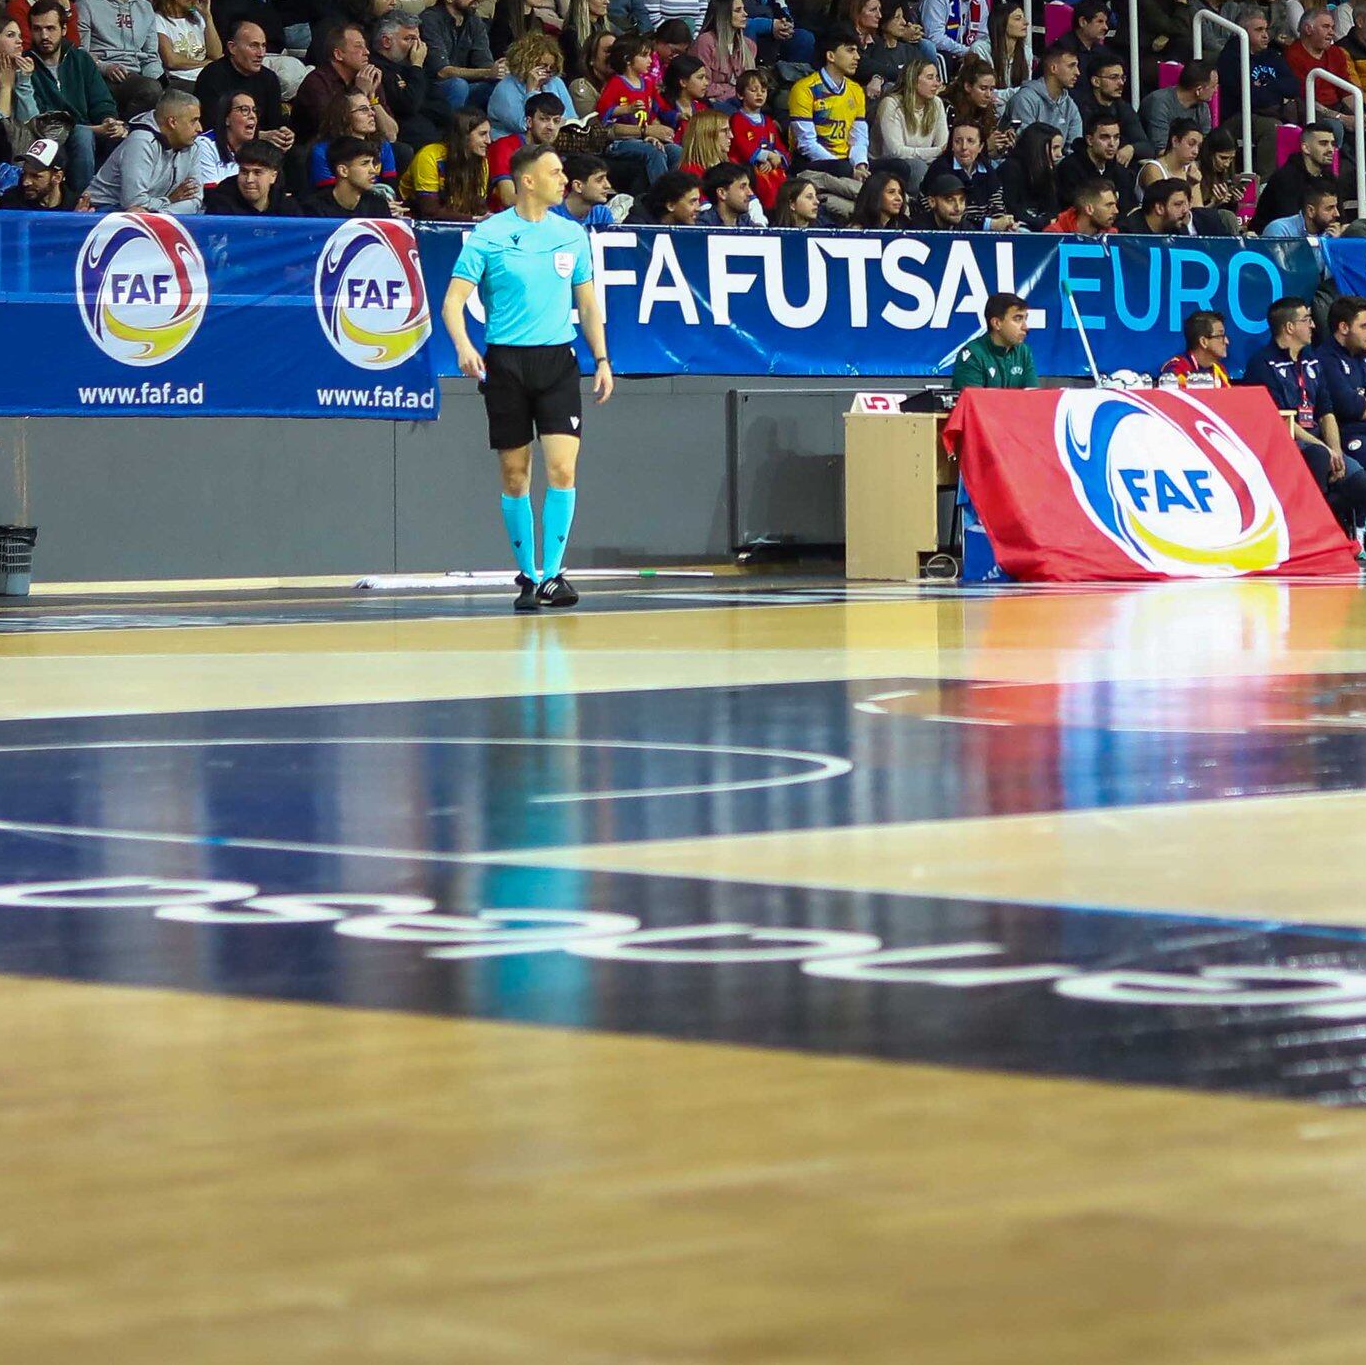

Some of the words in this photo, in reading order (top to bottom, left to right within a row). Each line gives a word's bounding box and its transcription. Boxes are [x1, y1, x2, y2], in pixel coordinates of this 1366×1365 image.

[830, 120, 846, 139] 23
[111, 273, 173, 305] FAF
[347, 278, 405, 310] FAF
[707, 234, 1046, 332] FUTSAL
[1058, 242, 1285, 334] EURO
[78, 383, 204, 405] www.faf.ad
[317, 386, 435, 410] www.faf.ad
[1117, 468, 1215, 514] FAF
